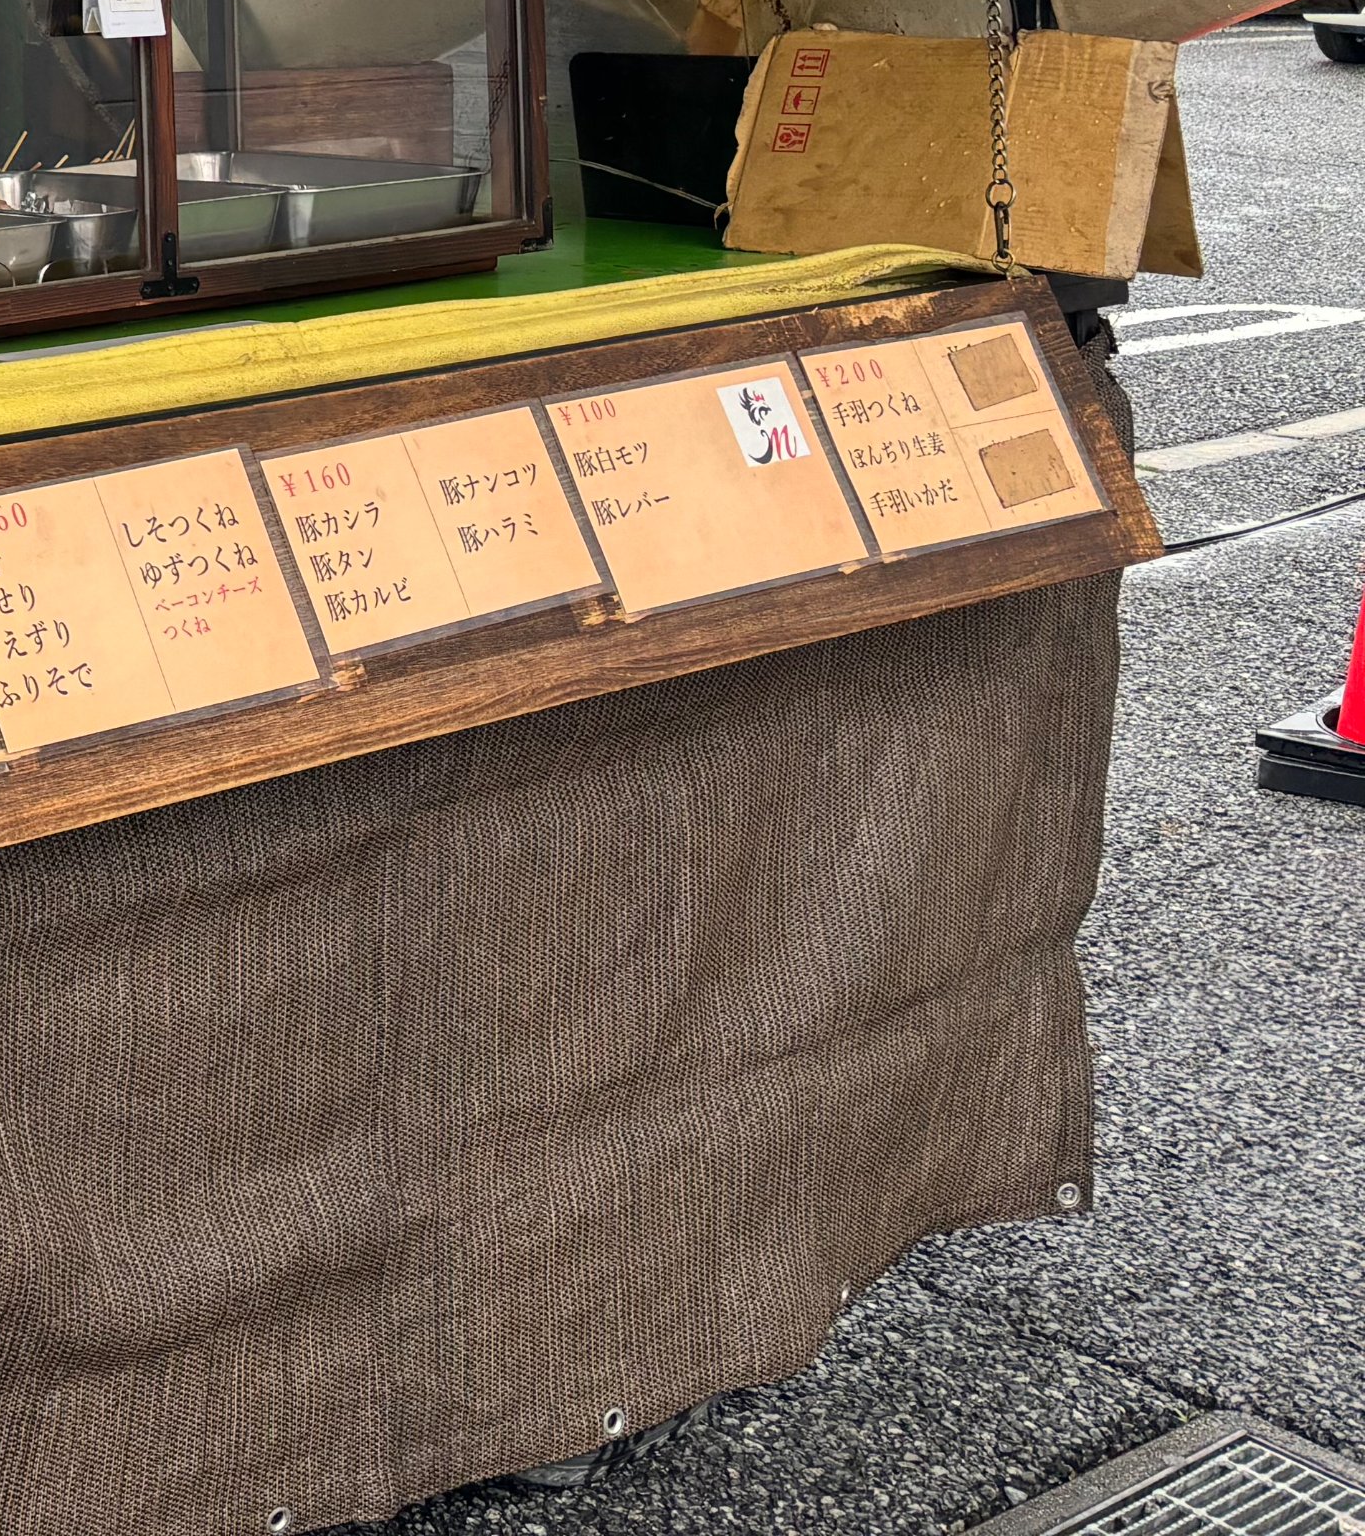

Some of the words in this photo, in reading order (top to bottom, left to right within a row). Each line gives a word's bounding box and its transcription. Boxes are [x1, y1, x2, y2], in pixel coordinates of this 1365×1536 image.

[815, 358, 884, 390] ¥200
[558, 397, 617, 427] ¥100
[831, 391, 922, 428] 手羽つくね
[573, 440, 648, 477] 豚白モツ
[848, 432, 947, 471] ぼんぢり生姜
[278, 462, 352, 498] ¥160
[439, 461, 539, 507] 豚ナンコツ
[868, 477, 959, 518] 手羽いかだ
[121, 501, 240, 549] しそつくね
[295, 499, 381, 545] 豚カシラ
[591, 489, 671, 527] 豚レバー
[457, 512, 539, 555] 豚ハラミ
[140, 543, 260, 588] ゆずつくね
[310, 545, 375, 584] 豚タン
[154, 575, 263, 612] ベーコンチーズ
[324, 576, 413, 624] 豚カルビ
[163, 614, 212, 641] つくね
